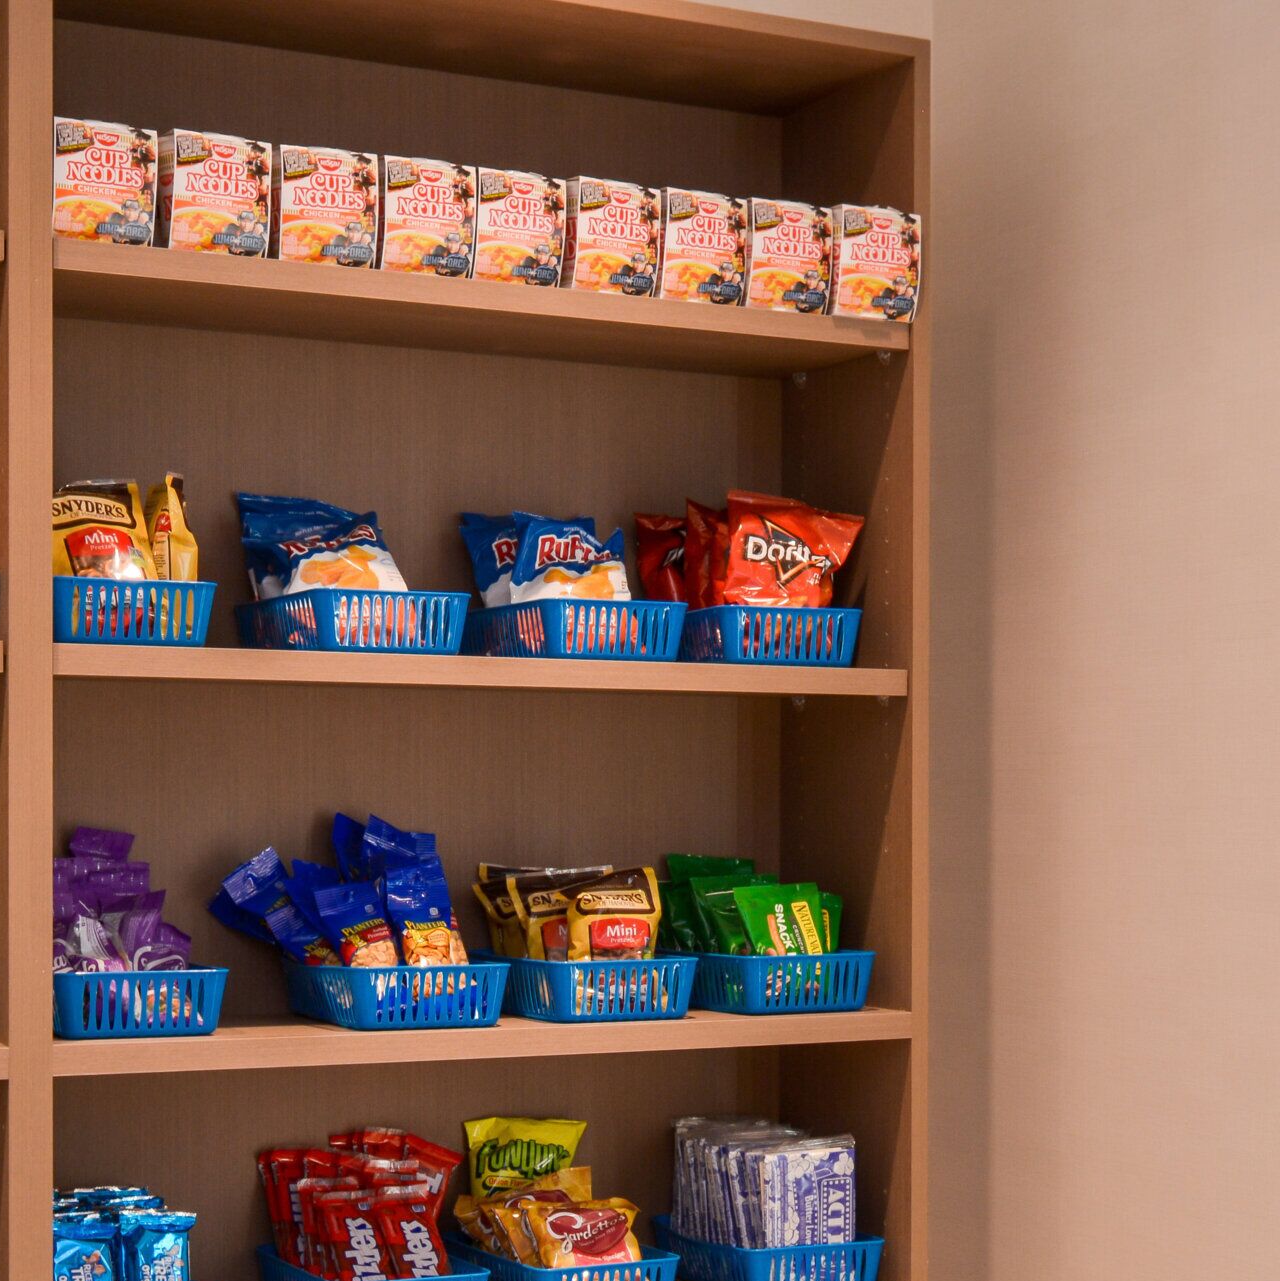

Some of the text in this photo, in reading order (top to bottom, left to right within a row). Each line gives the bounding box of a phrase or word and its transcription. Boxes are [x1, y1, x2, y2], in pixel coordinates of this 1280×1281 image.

[85, 147, 129, 168] CUP
[67, 162, 144, 189] NOODLES
[204, 159, 245, 180] CUP
[77, 184, 117, 196] CHICKEN
[186, 172, 260, 200] NOODLES
[310, 172, 351, 191] CUP
[195, 195, 233, 206] CHICKEN
[293, 187, 366, 211] NOODLES
[413, 183, 452, 202] CUP
[303, 209, 340, 219] CHICKEN
[397, 198, 465, 223] NOODLES
[504, 196, 543, 214] CUP
[603, 204, 640, 224] CUP
[406, 219, 440, 229] CHICKEN
[488, 209, 555, 234] NOODLES
[588, 217, 651, 242] NOODLES
[691, 215, 727, 234] CUP
[676, 228, 738, 252] NOODLES
[776, 223, 813, 243] CUP
[865, 230, 902, 250] CUP
[762, 238, 822, 260] NOODLES
[851, 244, 912, 267] NOODLES
[52, 499, 125, 518] SNYDER'S
[84, 530, 118, 545] Mini
[581, 893, 644, 905] SNDER'S
[341, 918, 385, 936] PLANTERS
[404, 920, 448, 930] PLANTERS
[606, 924, 637, 937] Mini
[774, 903, 795, 949] SNACK
[793, 904, 815, 938] NATURE
[828, 1187, 844, 1228] ACT
